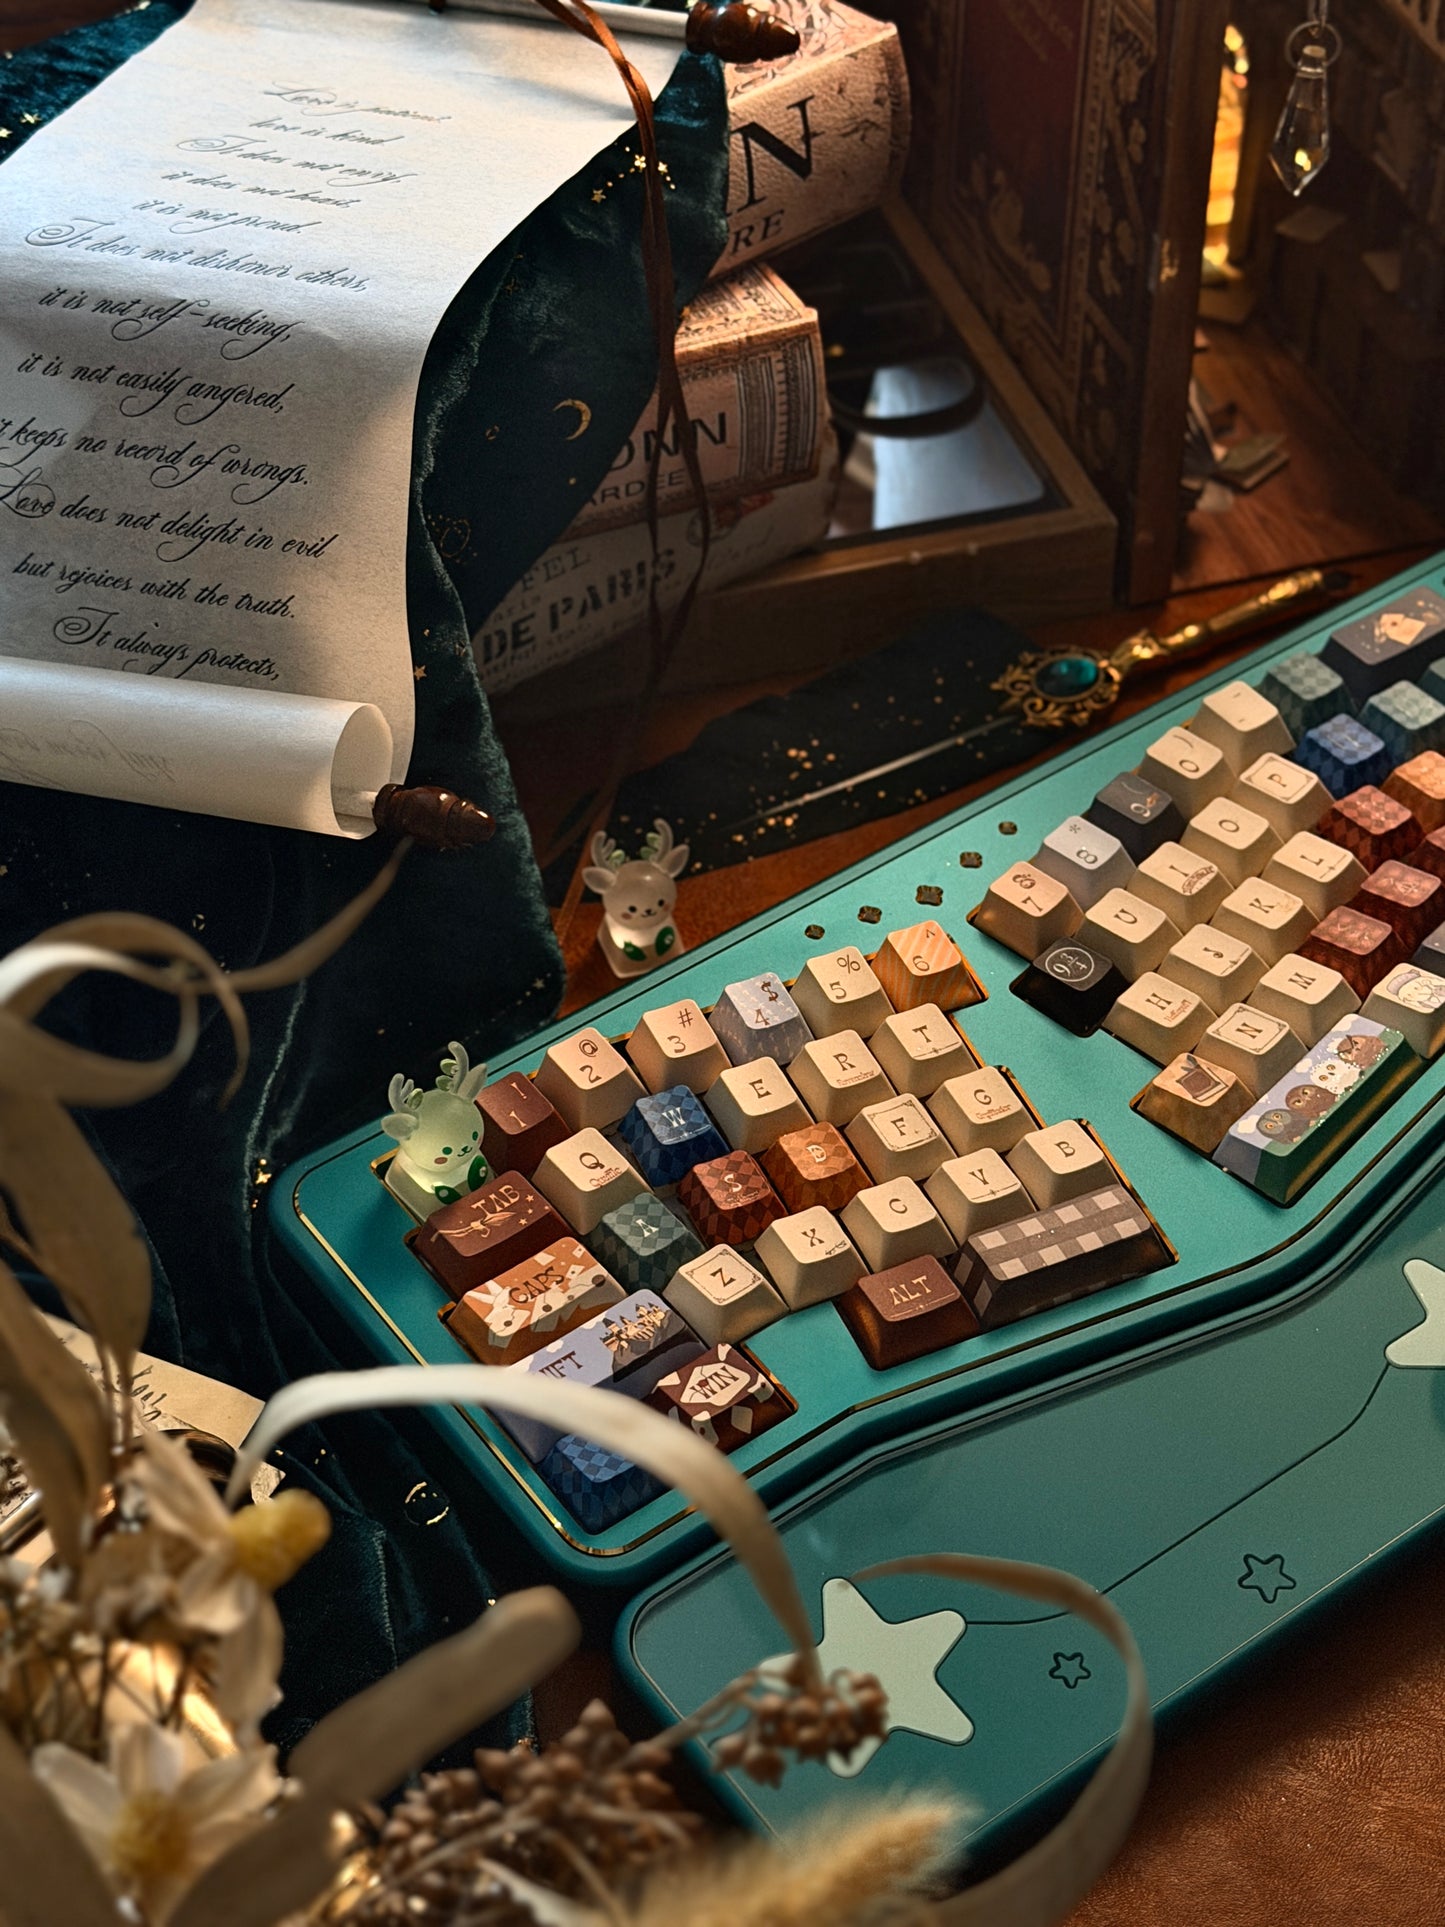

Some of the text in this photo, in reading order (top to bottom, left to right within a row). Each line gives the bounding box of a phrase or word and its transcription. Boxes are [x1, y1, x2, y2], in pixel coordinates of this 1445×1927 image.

[237, 150, 290, 164] does
[292, 161, 344, 172] not
[726, 95, 816, 217] N
[162, 171, 193, 181] it
[187, 175, 236, 190] does
[243, 186, 296, 196] not
[132, 199, 160, 211] it
[161, 202, 184, 215] is
[187, 208, 238, 221] not
[25, 218, 368, 293] It does not dishonor others,
[38, 286, 304, 361] it is not self-seeking,
[17, 353, 296, 426] it is not easily angered,
[0, 417, 68, 468] keeps
[75, 432, 105, 454] no
[113, 440, 197, 466] record
[150, 443, 241, 489] of
[221, 457, 309, 505] wrongs.
[0, 463, 340, 563] Love does not delight in evil
[11, 552, 297, 619] but rejoices with the truth.
[482, 612, 536, 665] DE
[550, 548, 676, 633] PARIS
[52, 606, 280, 681] It always protects,
[1267, 773, 1288, 788] P
[1129, 802, 1151, 818] 9
[1076, 848, 1098, 865] 8
[1299, 853, 1325, 867] L
[1021, 896, 1045, 913] 7
[1248, 897, 1276, 914] K
[1114, 908, 1138, 925] U
[1202, 946, 1224, 960] J
[836, 954, 861, 974] %
[912, 954, 931, 972] 6
[761, 980, 779, 1002] $
[829, 981, 847, 1000] 5
[1288, 972, 1317, 991] M
[1145, 992, 1173, 1011] H
[677, 1008, 694, 1028] #
[755, 1009, 771, 1026] 4
[912, 1025, 932, 1044] T
[1235, 1021, 1264, 1040] N
[579, 1039, 599, 1057] @
[667, 1035, 686, 1053] 3
[832, 1053, 857, 1072] R
[579, 1065, 602, 1084] 2
[749, 1079, 772, 1099] E
[973, 1088, 993, 1105] G
[509, 1111, 527, 1128] 1
[661, 1106, 687, 1128] W
[890, 1117, 909, 1136] F
[806, 1144, 827, 1163] D
[1054, 1141, 1077, 1158] B
[579, 1152, 605, 1170] Q
[724, 1173, 743, 1192] S
[471, 1184, 521, 1217] TAB
[888, 1198, 908, 1215] C
[635, 1219, 659, 1238] A
[800, 1227, 825, 1247] X
[508, 1266, 566, 1305] CAPS
[709, 1266, 736, 1288] Z
[888, 1275, 932, 1306] ALT
[688, 1365, 740, 1400] WIN
